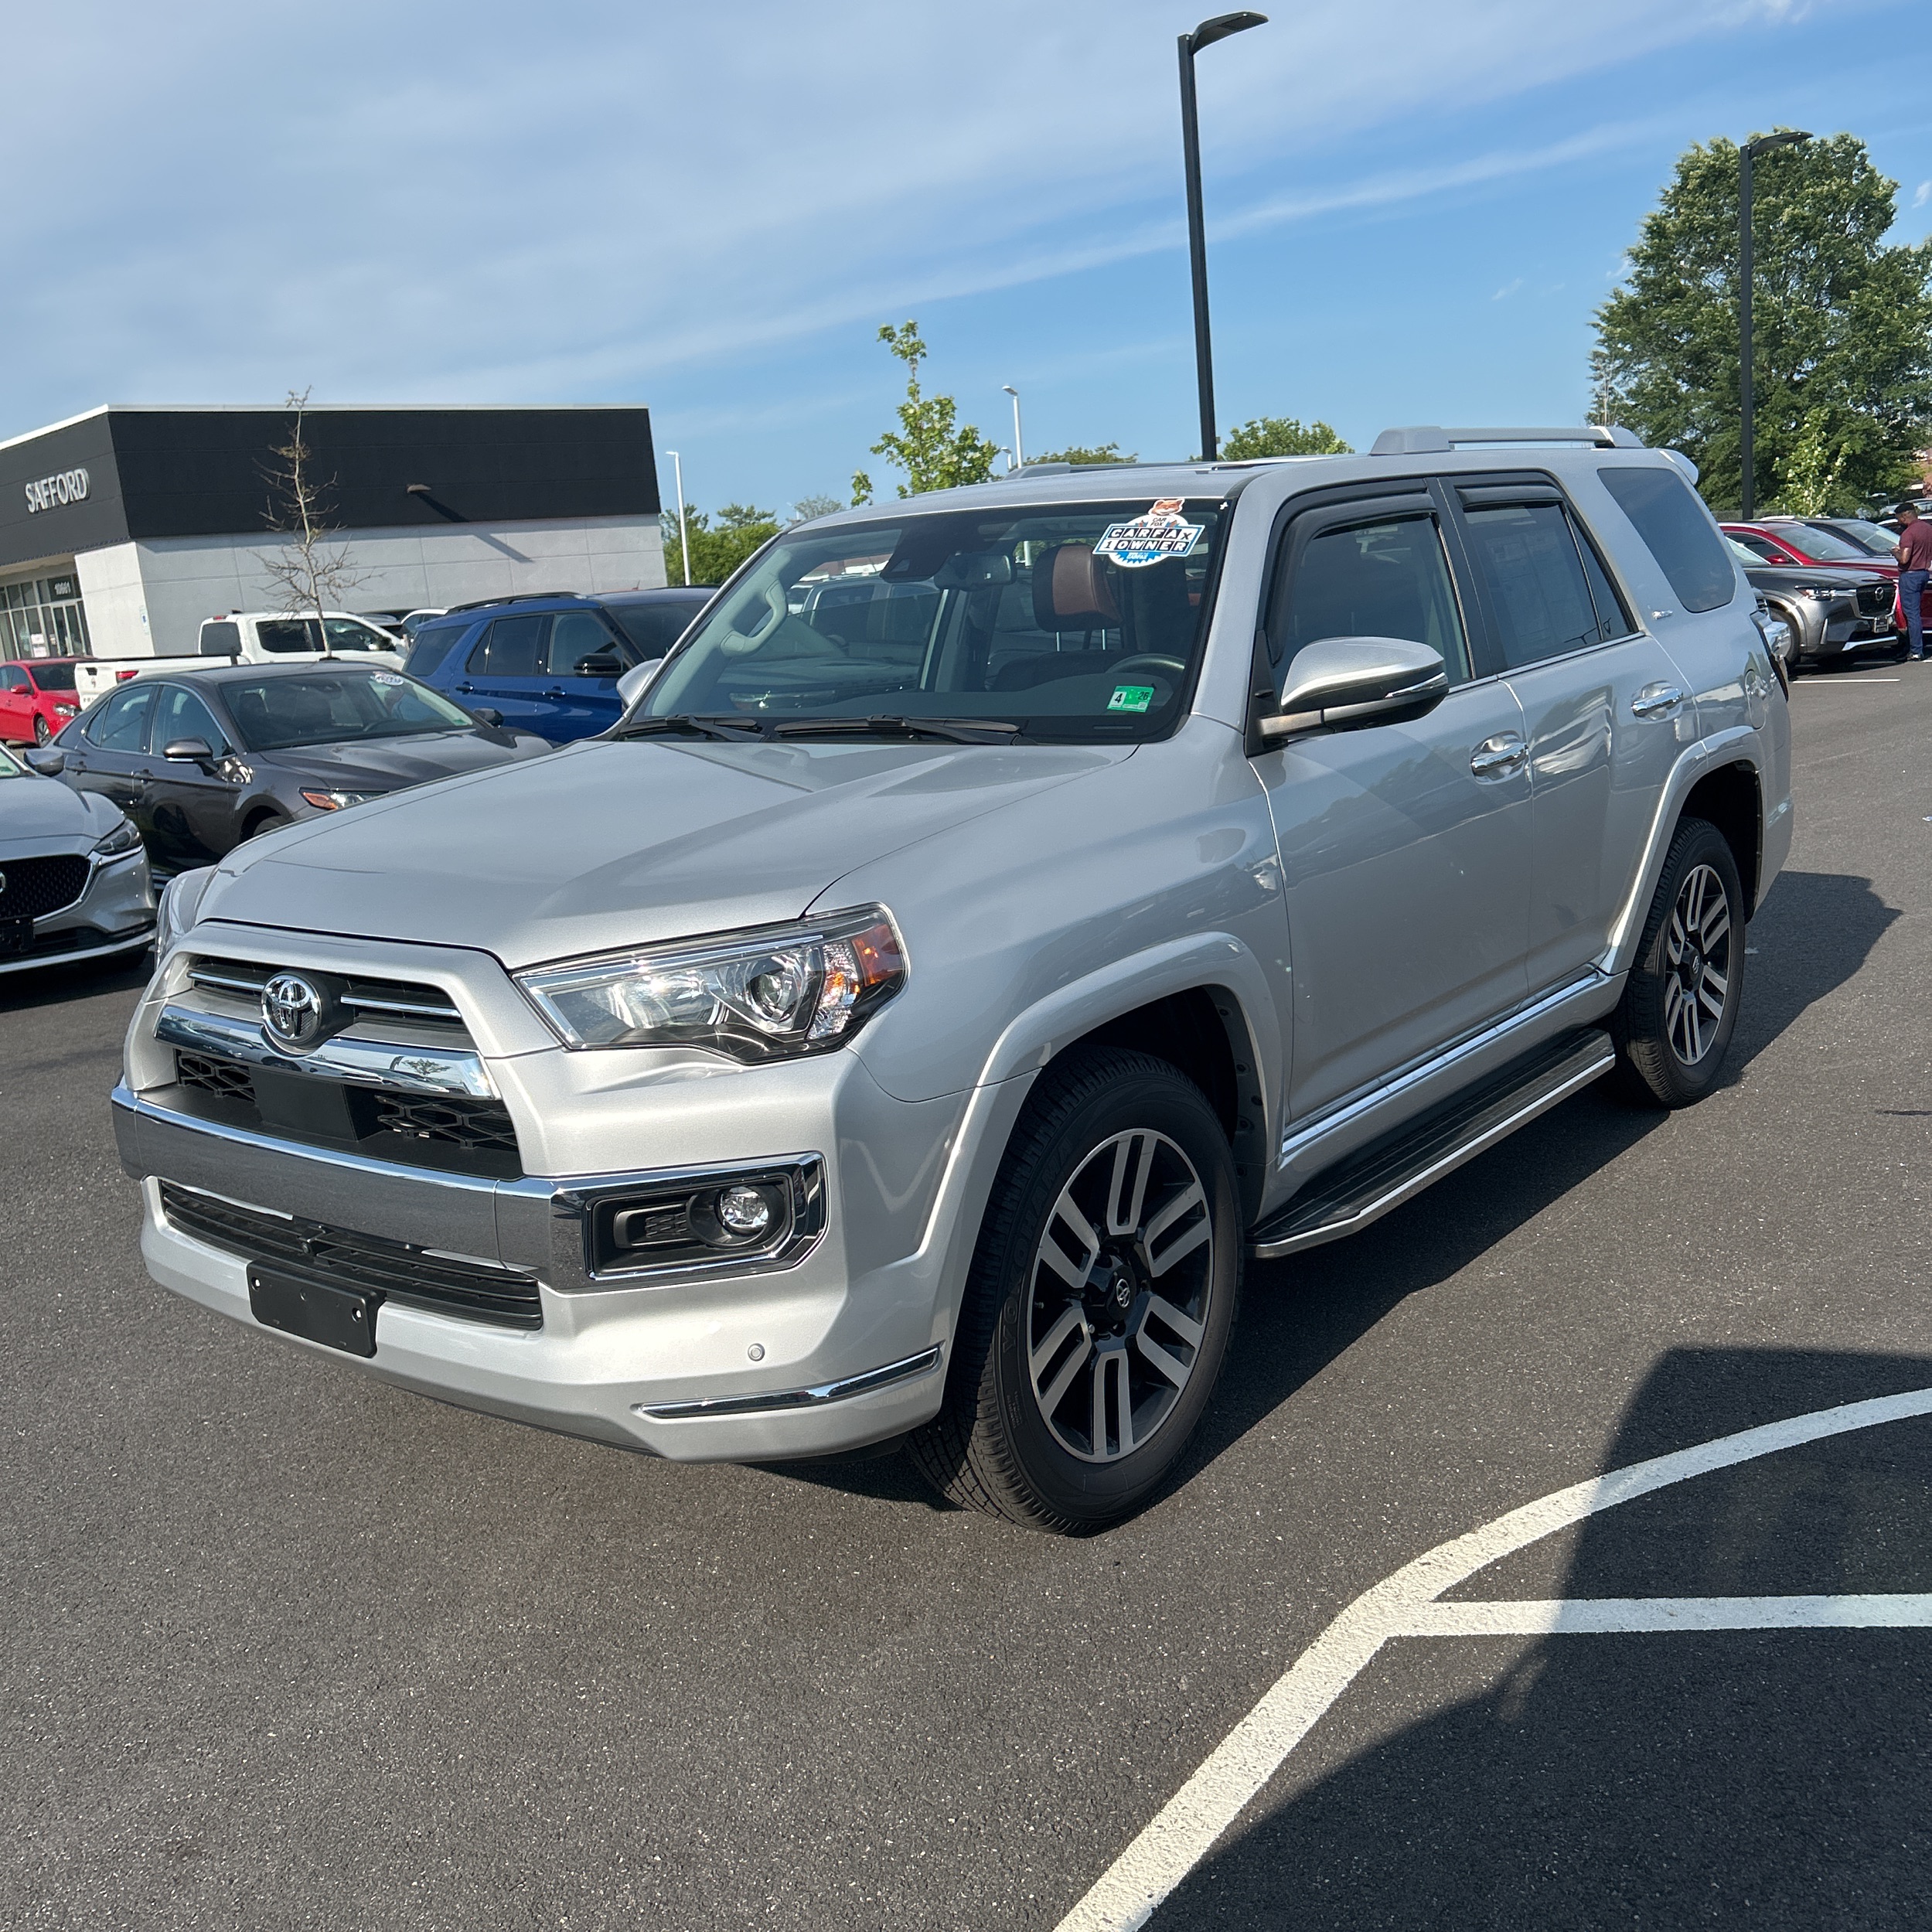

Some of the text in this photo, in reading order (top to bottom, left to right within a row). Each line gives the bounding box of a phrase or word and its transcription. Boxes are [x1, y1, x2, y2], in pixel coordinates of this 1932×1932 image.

[26, 469, 90, 513] SAFFORD
[1110, 528, 1193, 540] CARFAX
[1116, 540, 1187, 552] OWNER
[1114, 691, 1150, 704] 4 26
